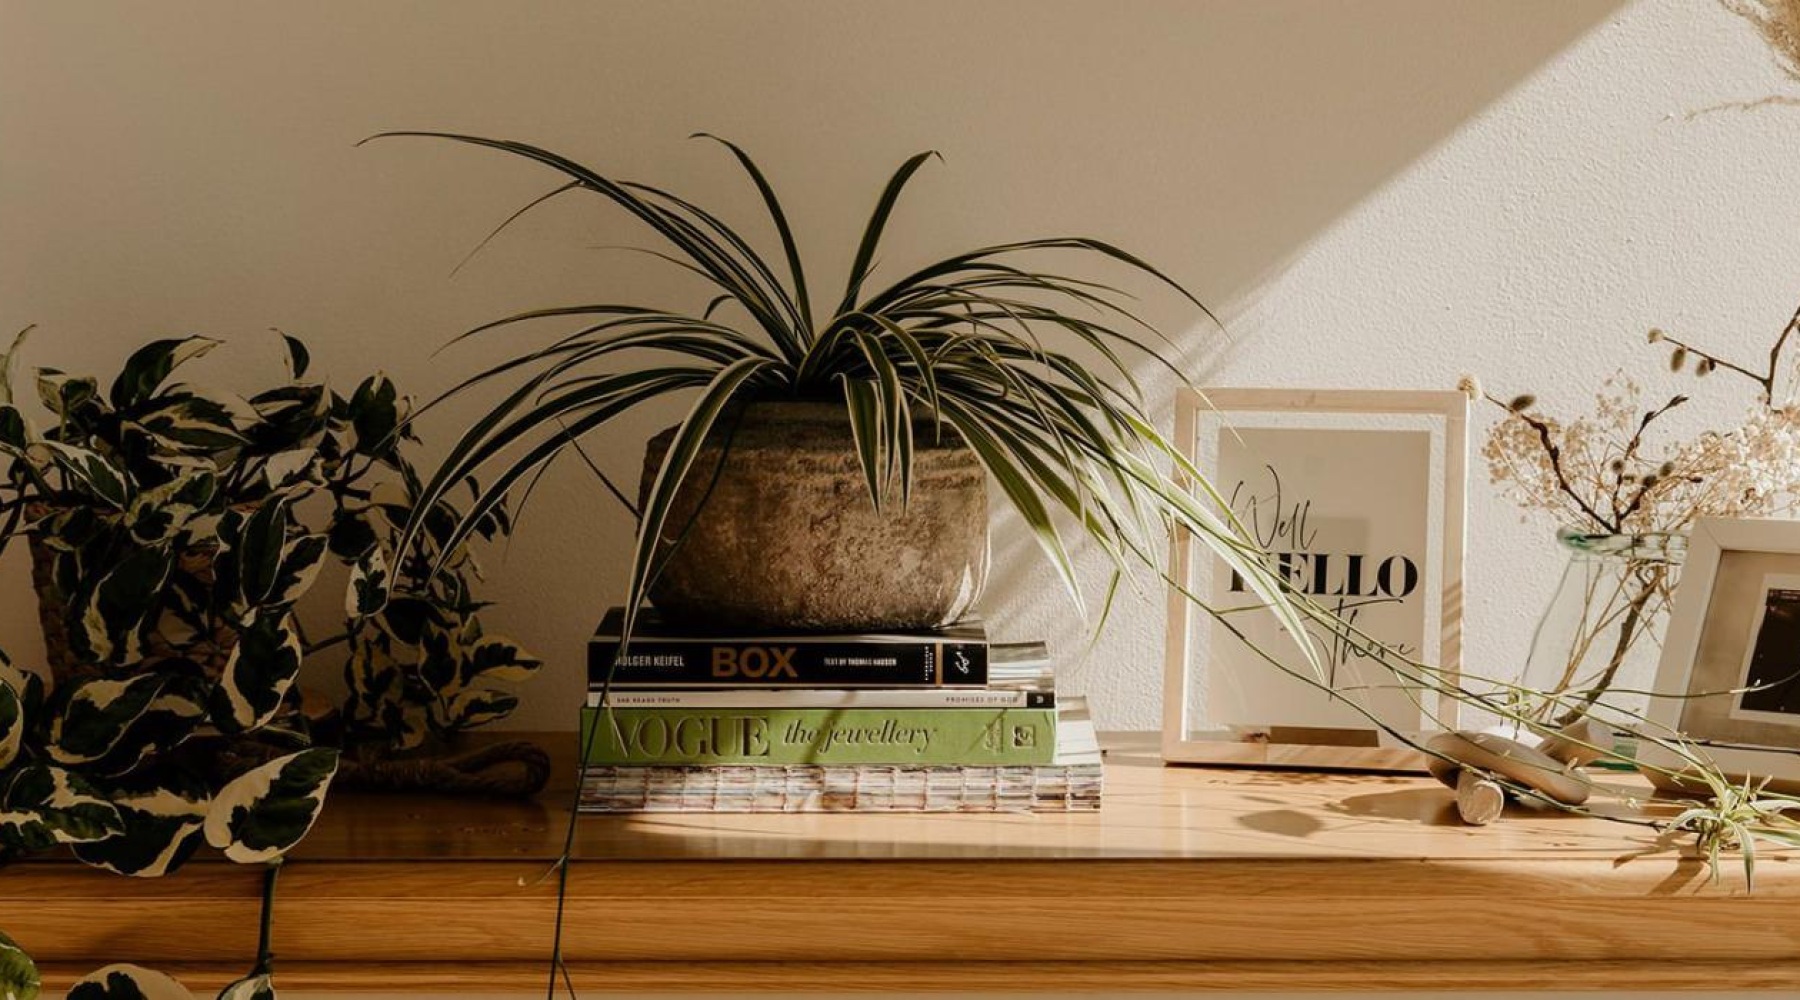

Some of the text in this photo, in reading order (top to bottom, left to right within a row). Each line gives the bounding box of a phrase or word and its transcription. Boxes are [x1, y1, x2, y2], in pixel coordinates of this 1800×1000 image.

[1227, 463, 1318, 550] Well
[653, 655, 685, 667] KEIFEL
[711, 646, 798, 678] BOX
[608, 715, 770, 758] VOGUE
[782, 719, 937, 754] the jewellery
